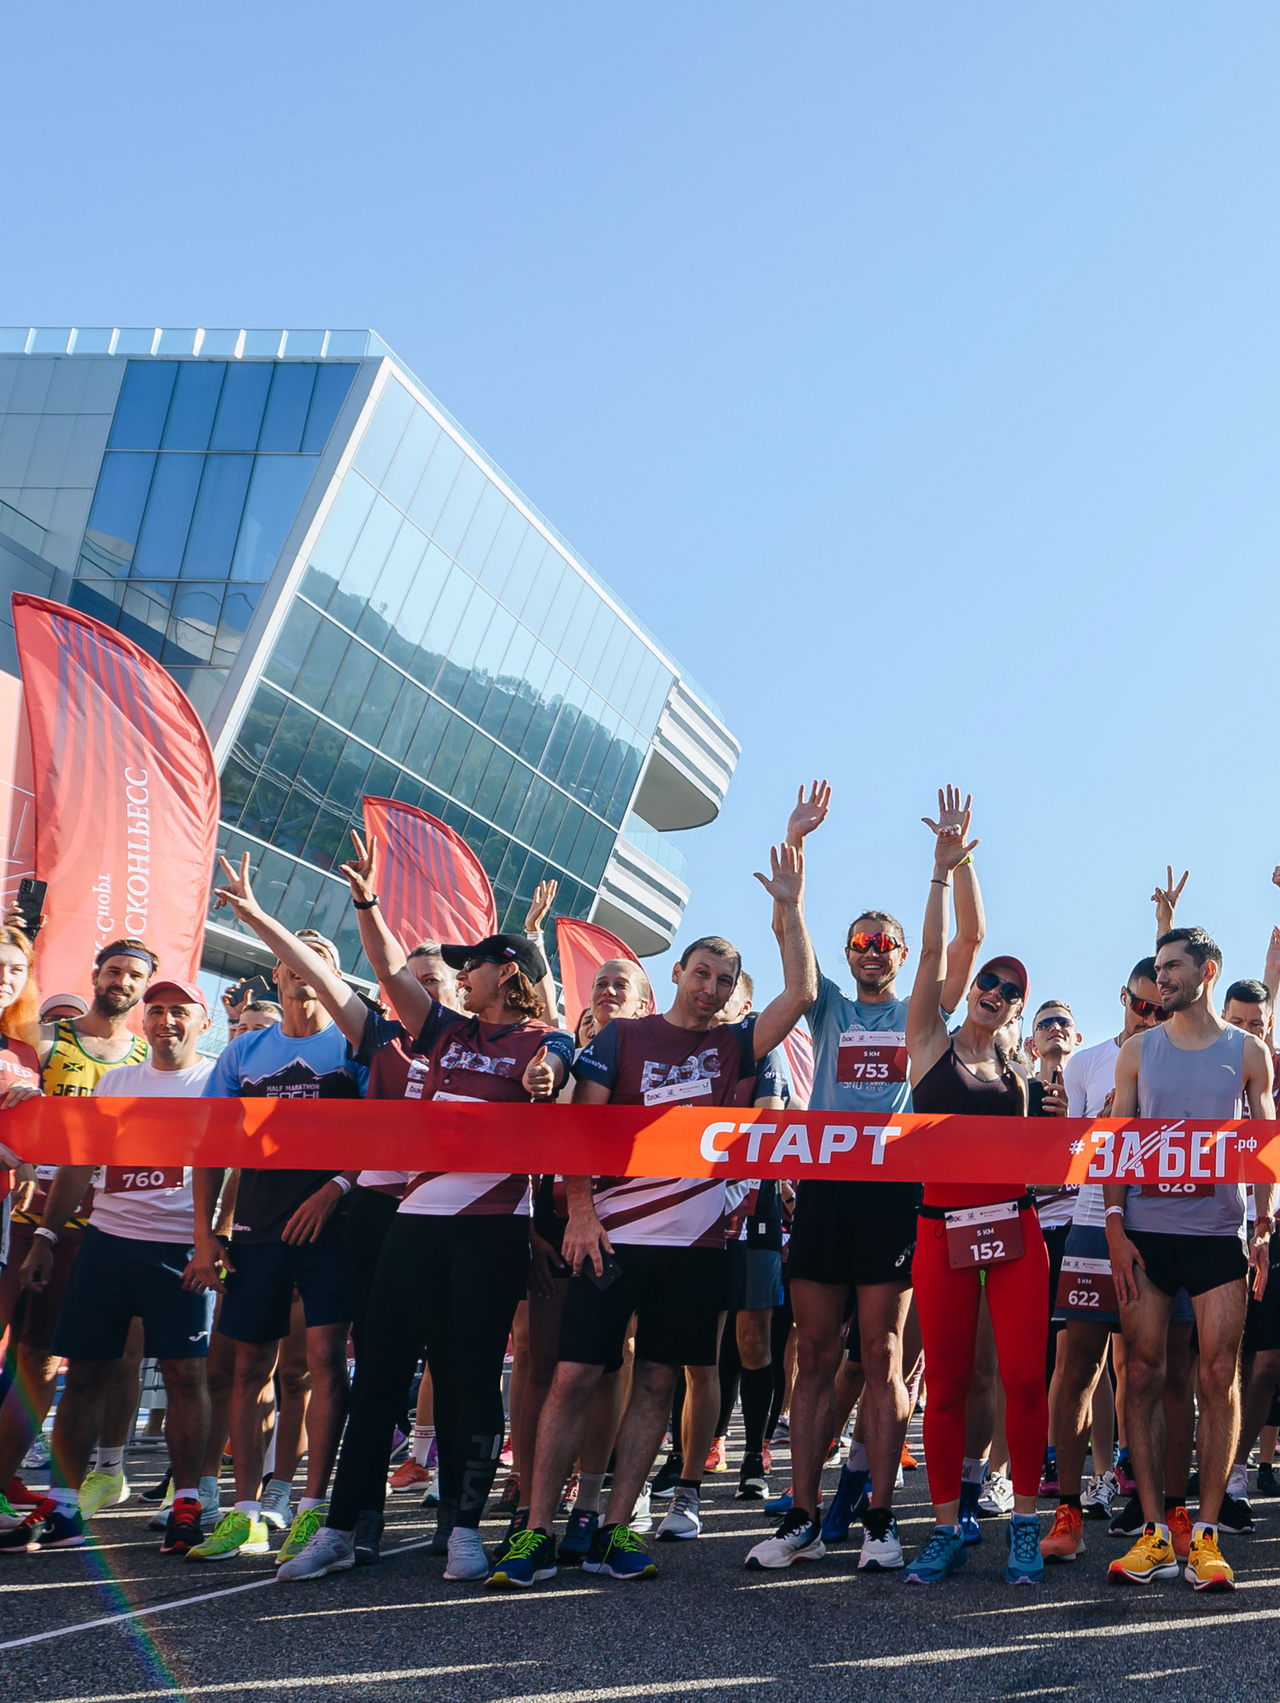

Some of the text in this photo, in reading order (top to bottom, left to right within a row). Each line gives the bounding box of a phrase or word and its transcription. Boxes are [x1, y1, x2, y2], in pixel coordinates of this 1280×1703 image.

[853, 1063, 889, 1079] 753
[285, 1083, 320, 1091] MARATHON
[700, 1121, 902, 1166] СТАРТ
[122, 1170, 165, 1189] 760
[976, 1229, 982, 1237] 5
[970, 1240, 1006, 1261] 152
[1068, 1290, 1100, 1307] 622
